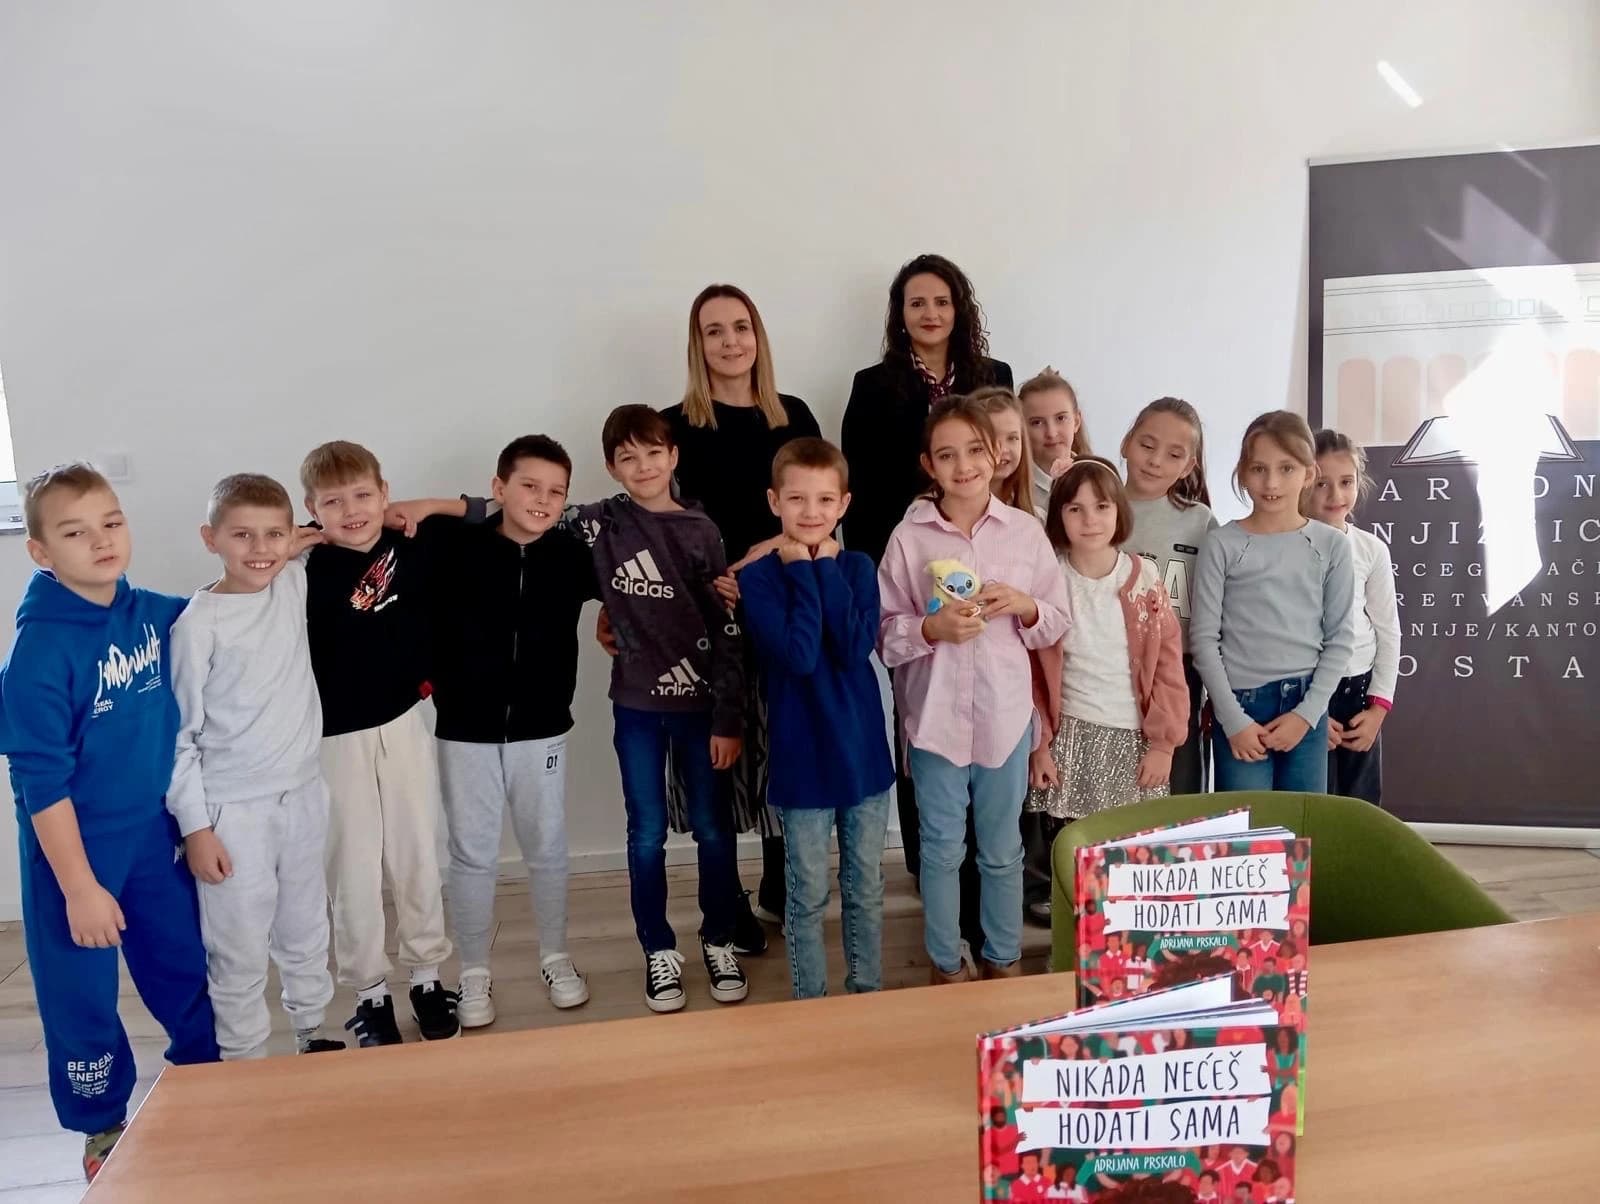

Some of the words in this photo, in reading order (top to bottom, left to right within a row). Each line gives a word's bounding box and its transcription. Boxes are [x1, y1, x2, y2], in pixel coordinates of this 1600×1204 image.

[1400, 622, 1597, 641] NIJE/KANTO
[1398, 655, 1585, 679] OSTA
[1132, 866, 1199, 894] NIKADA
[1211, 857, 1269, 890] NEĆEŠ
[1133, 902, 1200, 929] HODATI
[1215, 898, 1268, 927] SAMA
[1160, 936, 1194, 950] ADRIJANA
[1196, 935, 1228, 948] PRSKALO
[67, 1061, 86, 1071] BE
[1055, 1063, 1146, 1098] NIKADA
[1164, 1050, 1243, 1094] NEĆEŠ
[1059, 1110, 1151, 1146] HODATI
[1170, 1105, 1241, 1142] SAMA
[1094, 1156, 1140, 1173] ADRIJANA
[1143, 1154, 1186, 1170] PRSKALO
